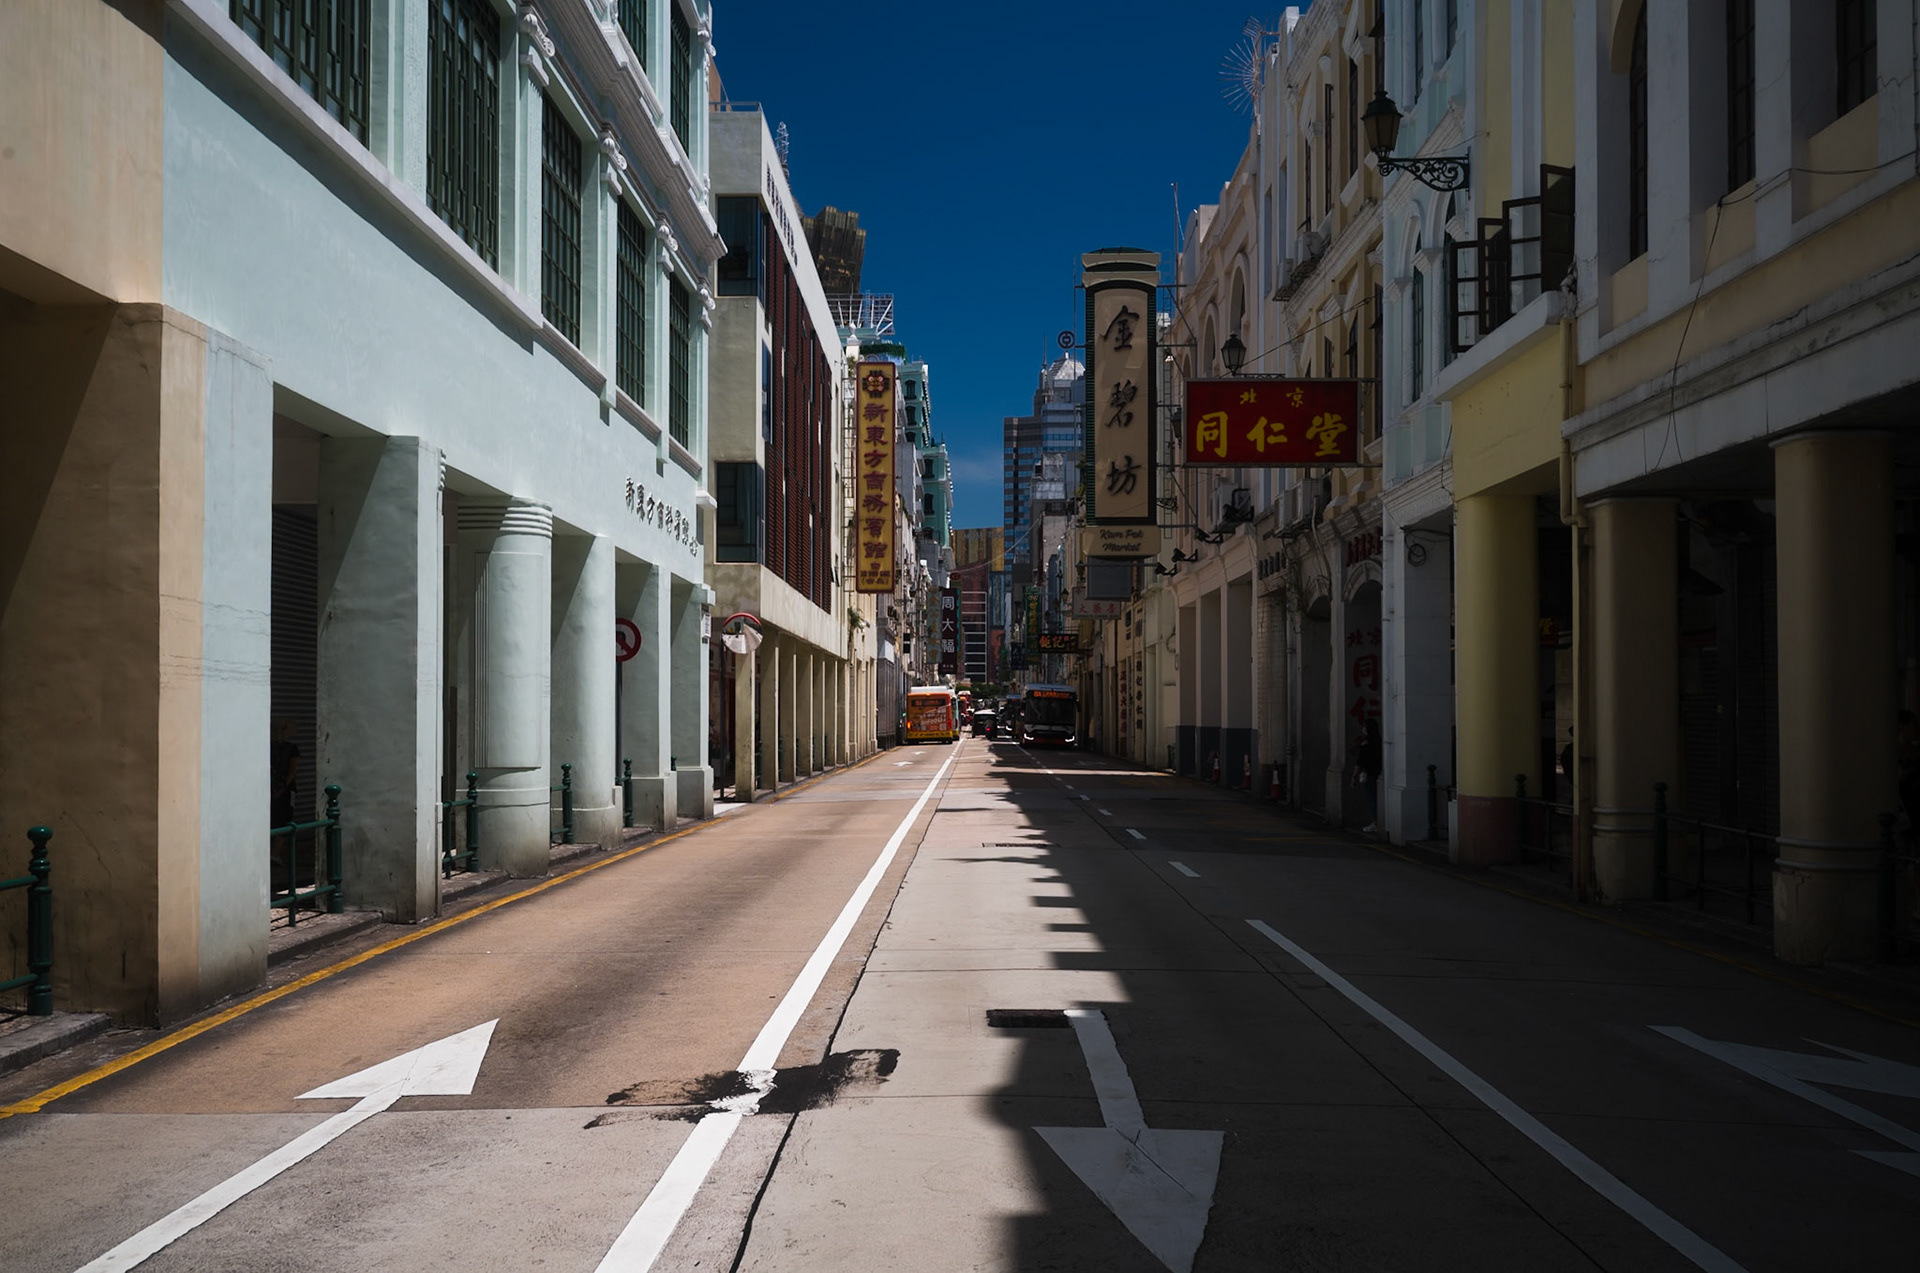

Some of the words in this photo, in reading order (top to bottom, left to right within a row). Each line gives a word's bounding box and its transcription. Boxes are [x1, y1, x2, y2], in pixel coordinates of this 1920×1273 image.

[1101, 305, 1144, 496] 金碧坊
[1239, 387, 1306, 409] 北京
[1195, 410, 1349, 459] 同仁堂
[1102, 542, 1142, 552] Market
[941, 595, 956, 653] 周大福
